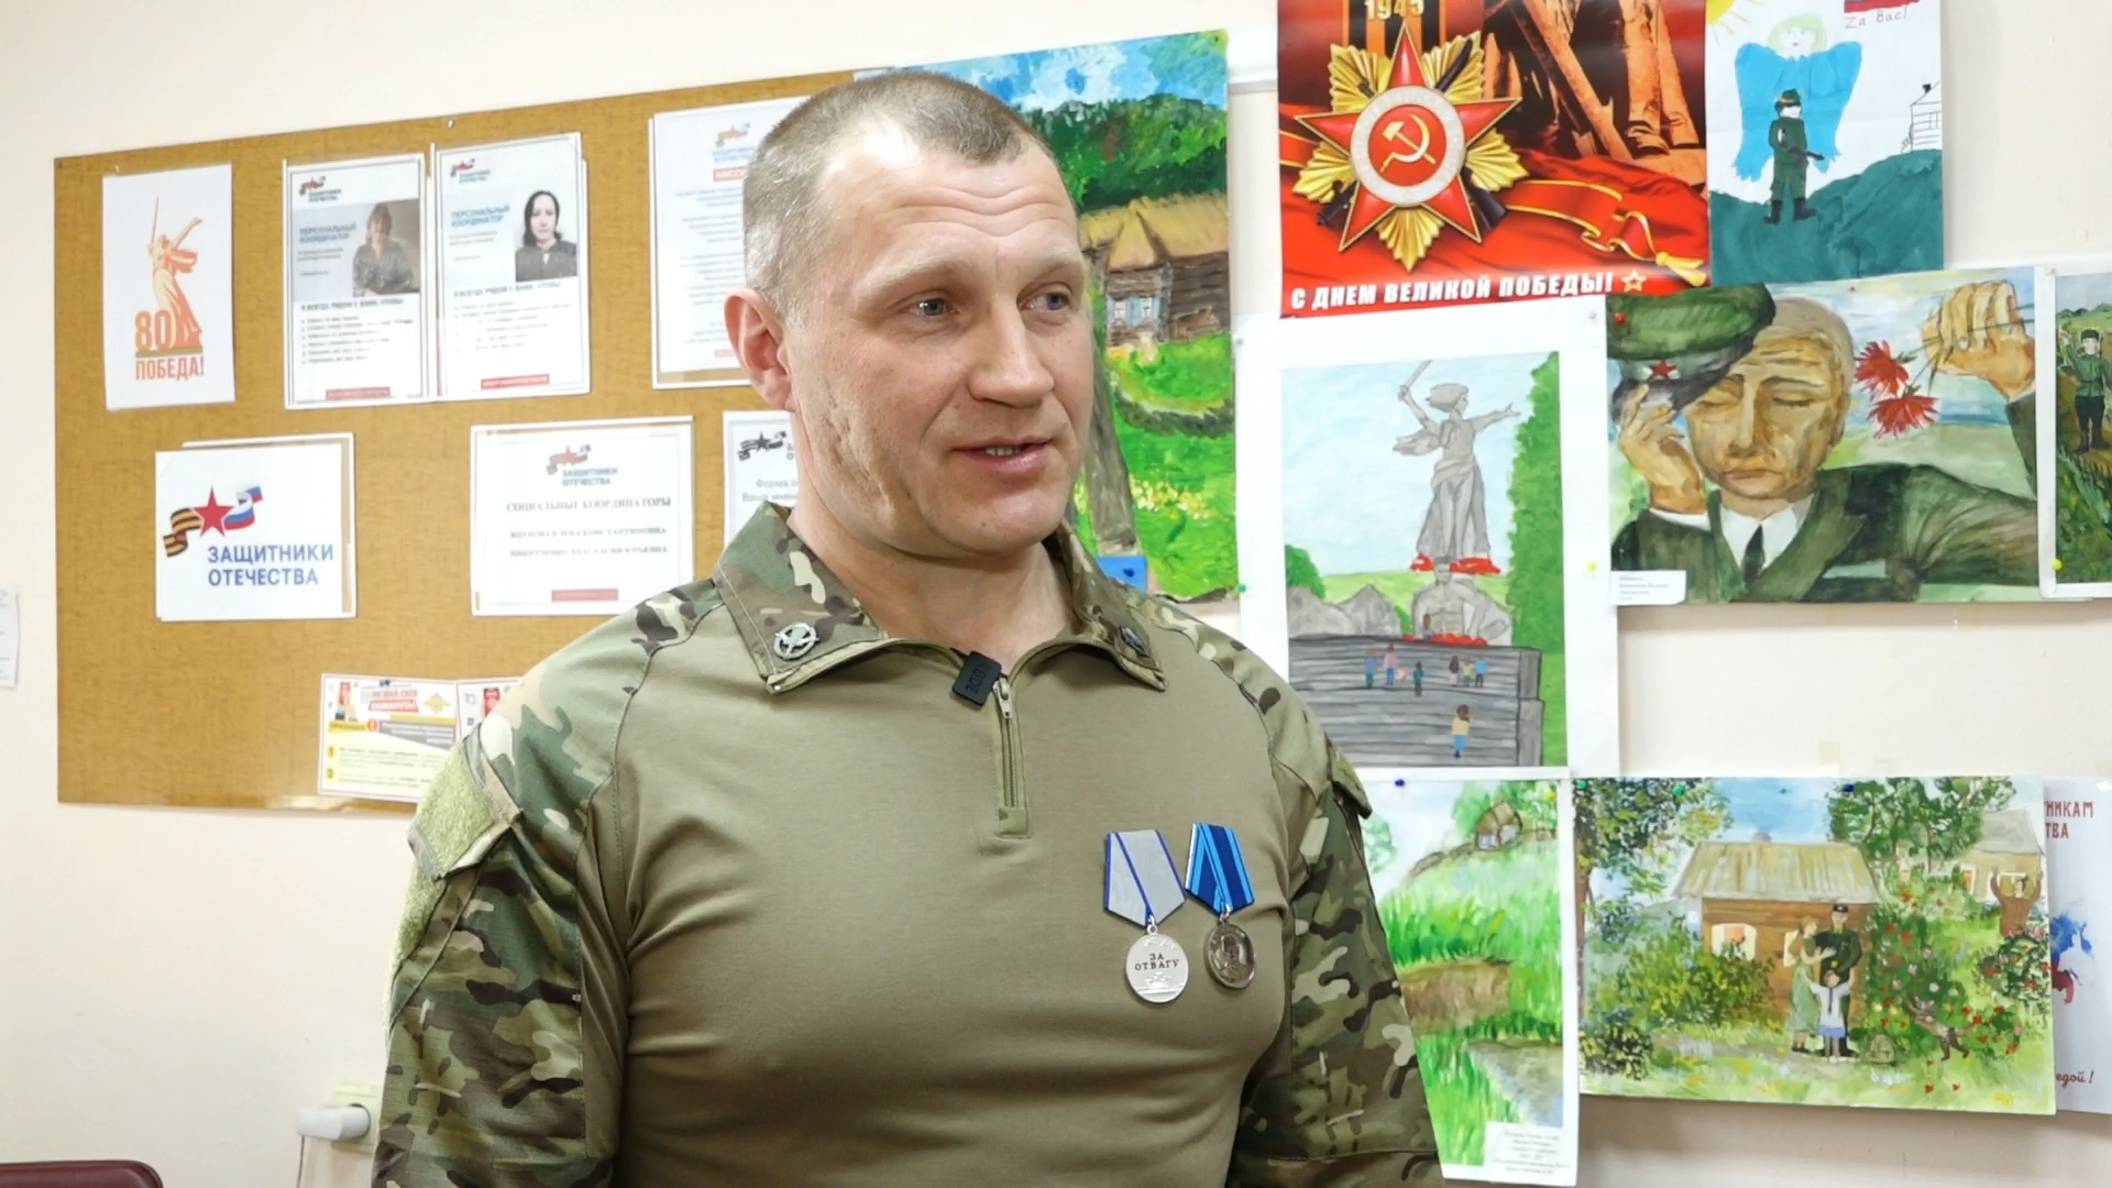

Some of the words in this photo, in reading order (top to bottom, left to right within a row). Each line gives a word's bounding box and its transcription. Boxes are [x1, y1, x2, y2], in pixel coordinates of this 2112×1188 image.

[1291, 288, 1306, 309] С
[1312, 284, 1376, 310] ДНЕМ
[1384, 274, 1491, 303] ВЕЛИКОЙ
[1499, 272, 1613, 297] ПОБЕДЫ!
[135, 309, 172, 352] 80
[136, 356, 204, 381] ПОБЕДА!
[208, 545, 334, 565] ЗАЩИТНИКИ
[208, 568, 319, 587] ОТЕЧЕСТВА
[1135, 959, 1179, 971] ОТВАГУ
